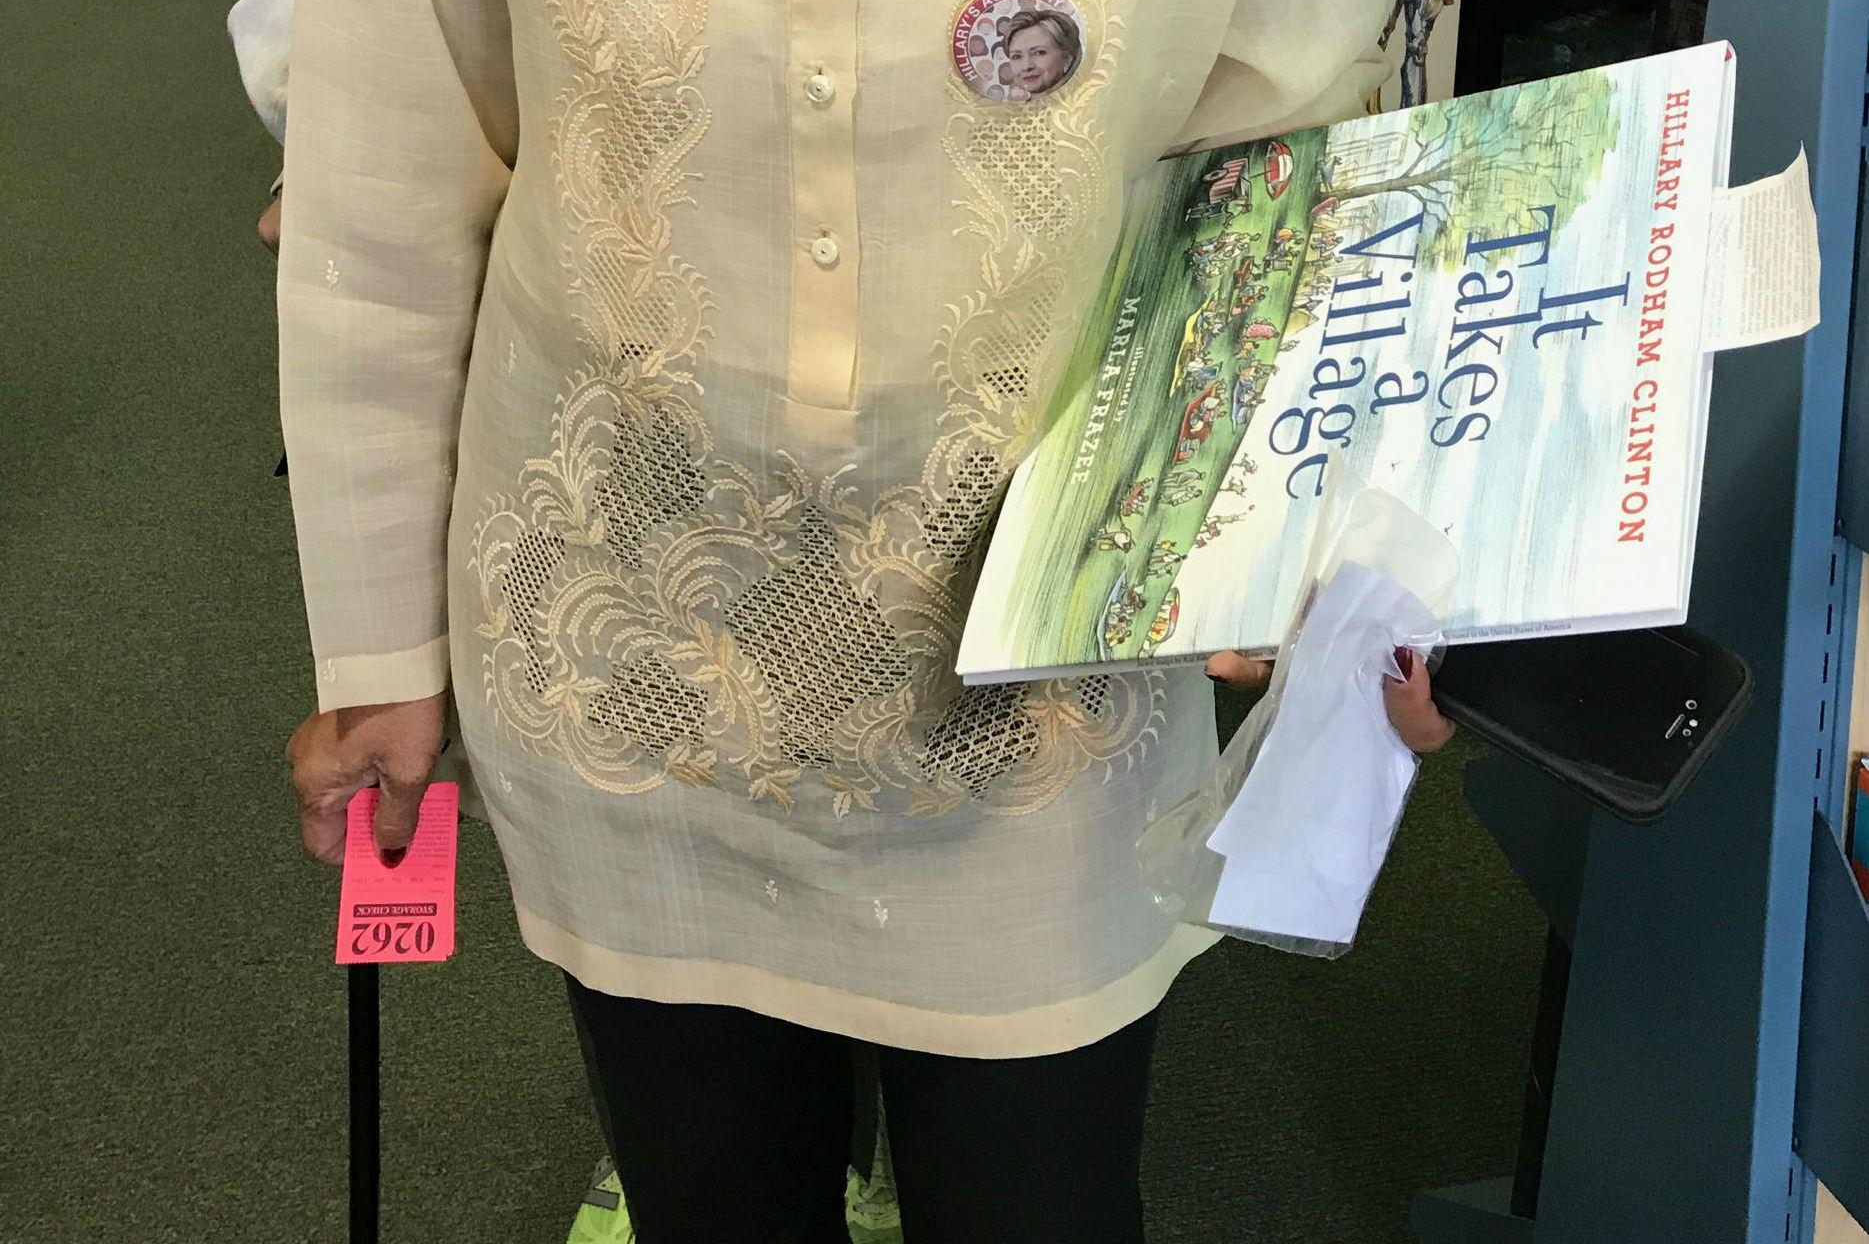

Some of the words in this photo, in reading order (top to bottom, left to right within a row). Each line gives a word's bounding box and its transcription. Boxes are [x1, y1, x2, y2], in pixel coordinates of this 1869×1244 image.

[954, 6, 981, 82] HILLARY'S
[1653, 88, 1690, 211] HILLARY
[1430, 204, 1556, 448] Takes
[1532, 271, 1631, 349] It
[1635, 223, 1675, 368] RODHAM
[1102, 296, 1141, 381] MARLA
[1269, 211, 1425, 500] Village
[1370, 369, 1429, 415] a
[1071, 388, 1115, 485] FRAZEE
[1617, 379, 1659, 544] CLINTON
[351, 921, 435, 955] 0262
[357, 905, 390, 916] CHECK
[392, 904, 434, 915] STORAGE
